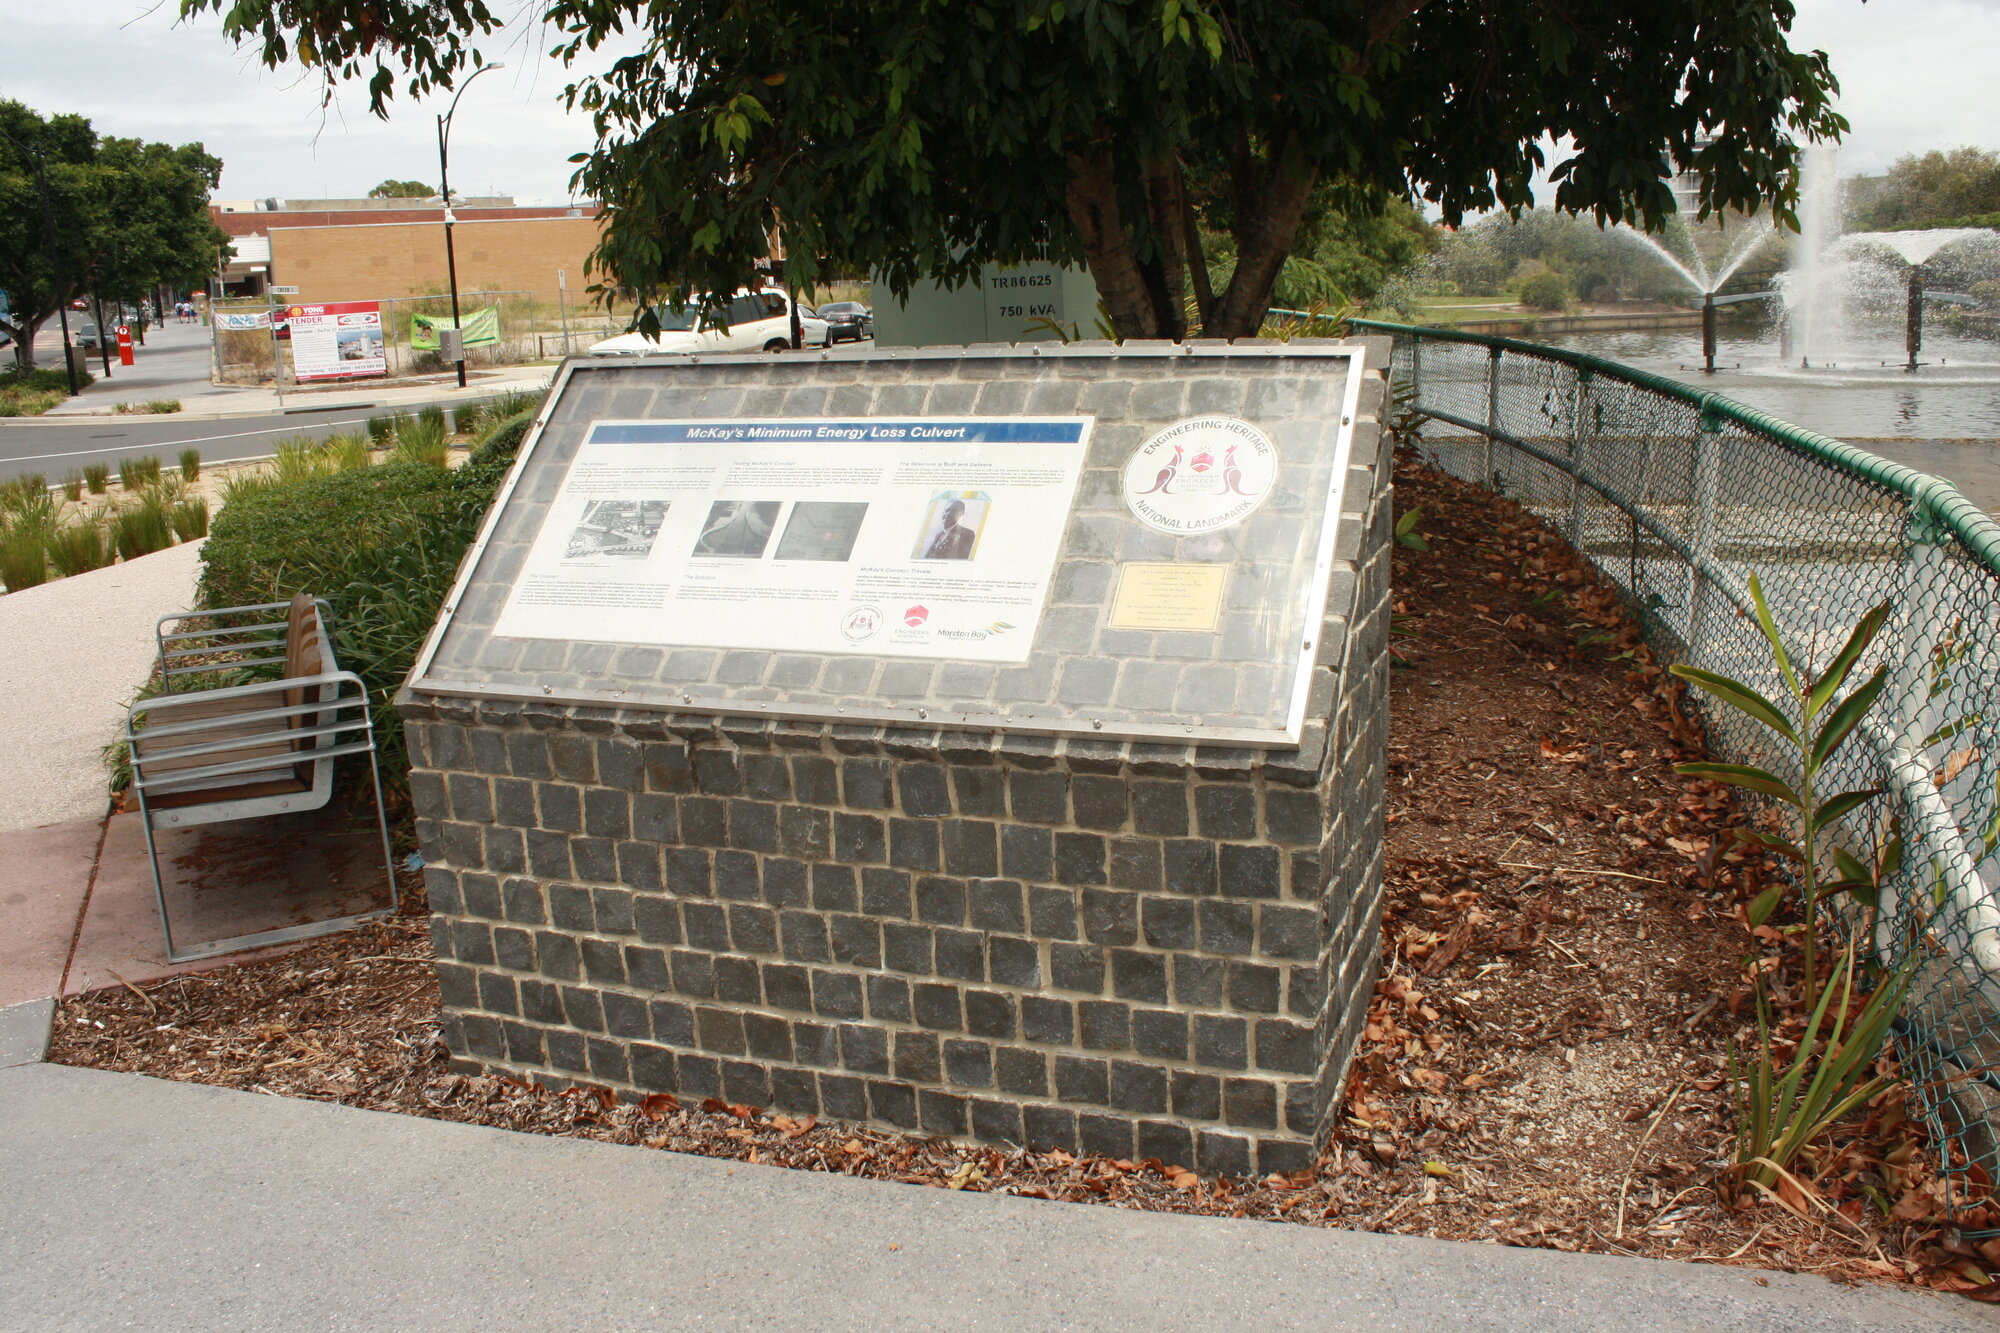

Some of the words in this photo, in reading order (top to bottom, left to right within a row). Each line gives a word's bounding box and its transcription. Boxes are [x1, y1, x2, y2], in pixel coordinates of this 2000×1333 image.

[1000, 305, 1023, 317] 750
[1030, 304, 1056, 316] kVA
[290, 316, 323, 325] TENDER
[686, 426, 744, 440] McKay's
[747, 426, 813, 438] Minimum
[816, 426, 868, 440] Energy
[870, 426, 906, 438] Loss
[910, 426, 966, 438] Culvert
[1143, 420, 1223, 456] ENGINEERING
[1224, 422, 1269, 456] HERITAGE
[1135, 499, 1182, 529] NATIONAL
[1186, 499, 1253, 529] LANDMARK
[860, 566, 884, 574] McKay's
[937, 629, 970, 638] Moreton
[971, 630, 987, 641] Bay
